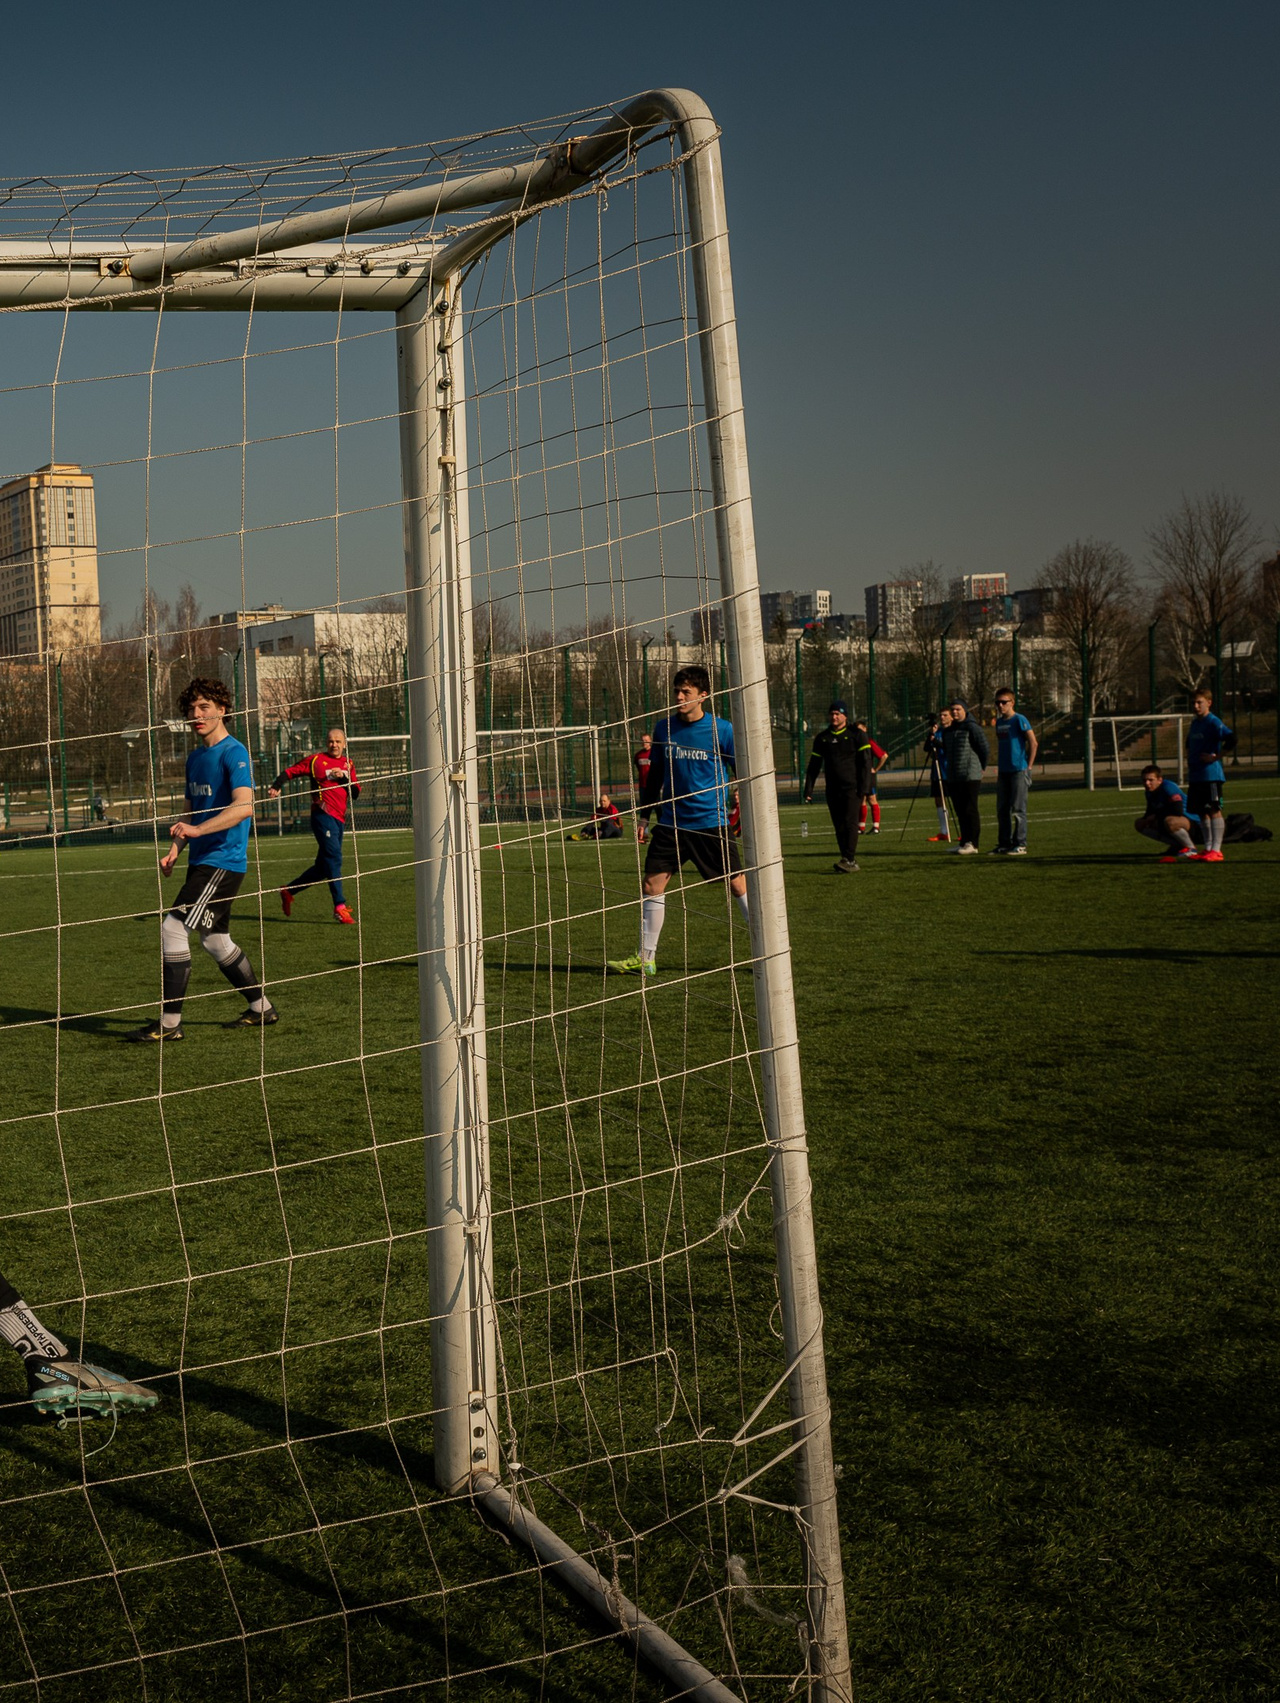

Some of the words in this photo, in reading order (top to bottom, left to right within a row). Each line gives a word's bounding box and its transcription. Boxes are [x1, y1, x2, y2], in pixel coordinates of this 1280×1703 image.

[675, 747, 707, 760] Личность
[201, 909, 215, 929] 96
[40, 1366, 70, 1382] MESSI
